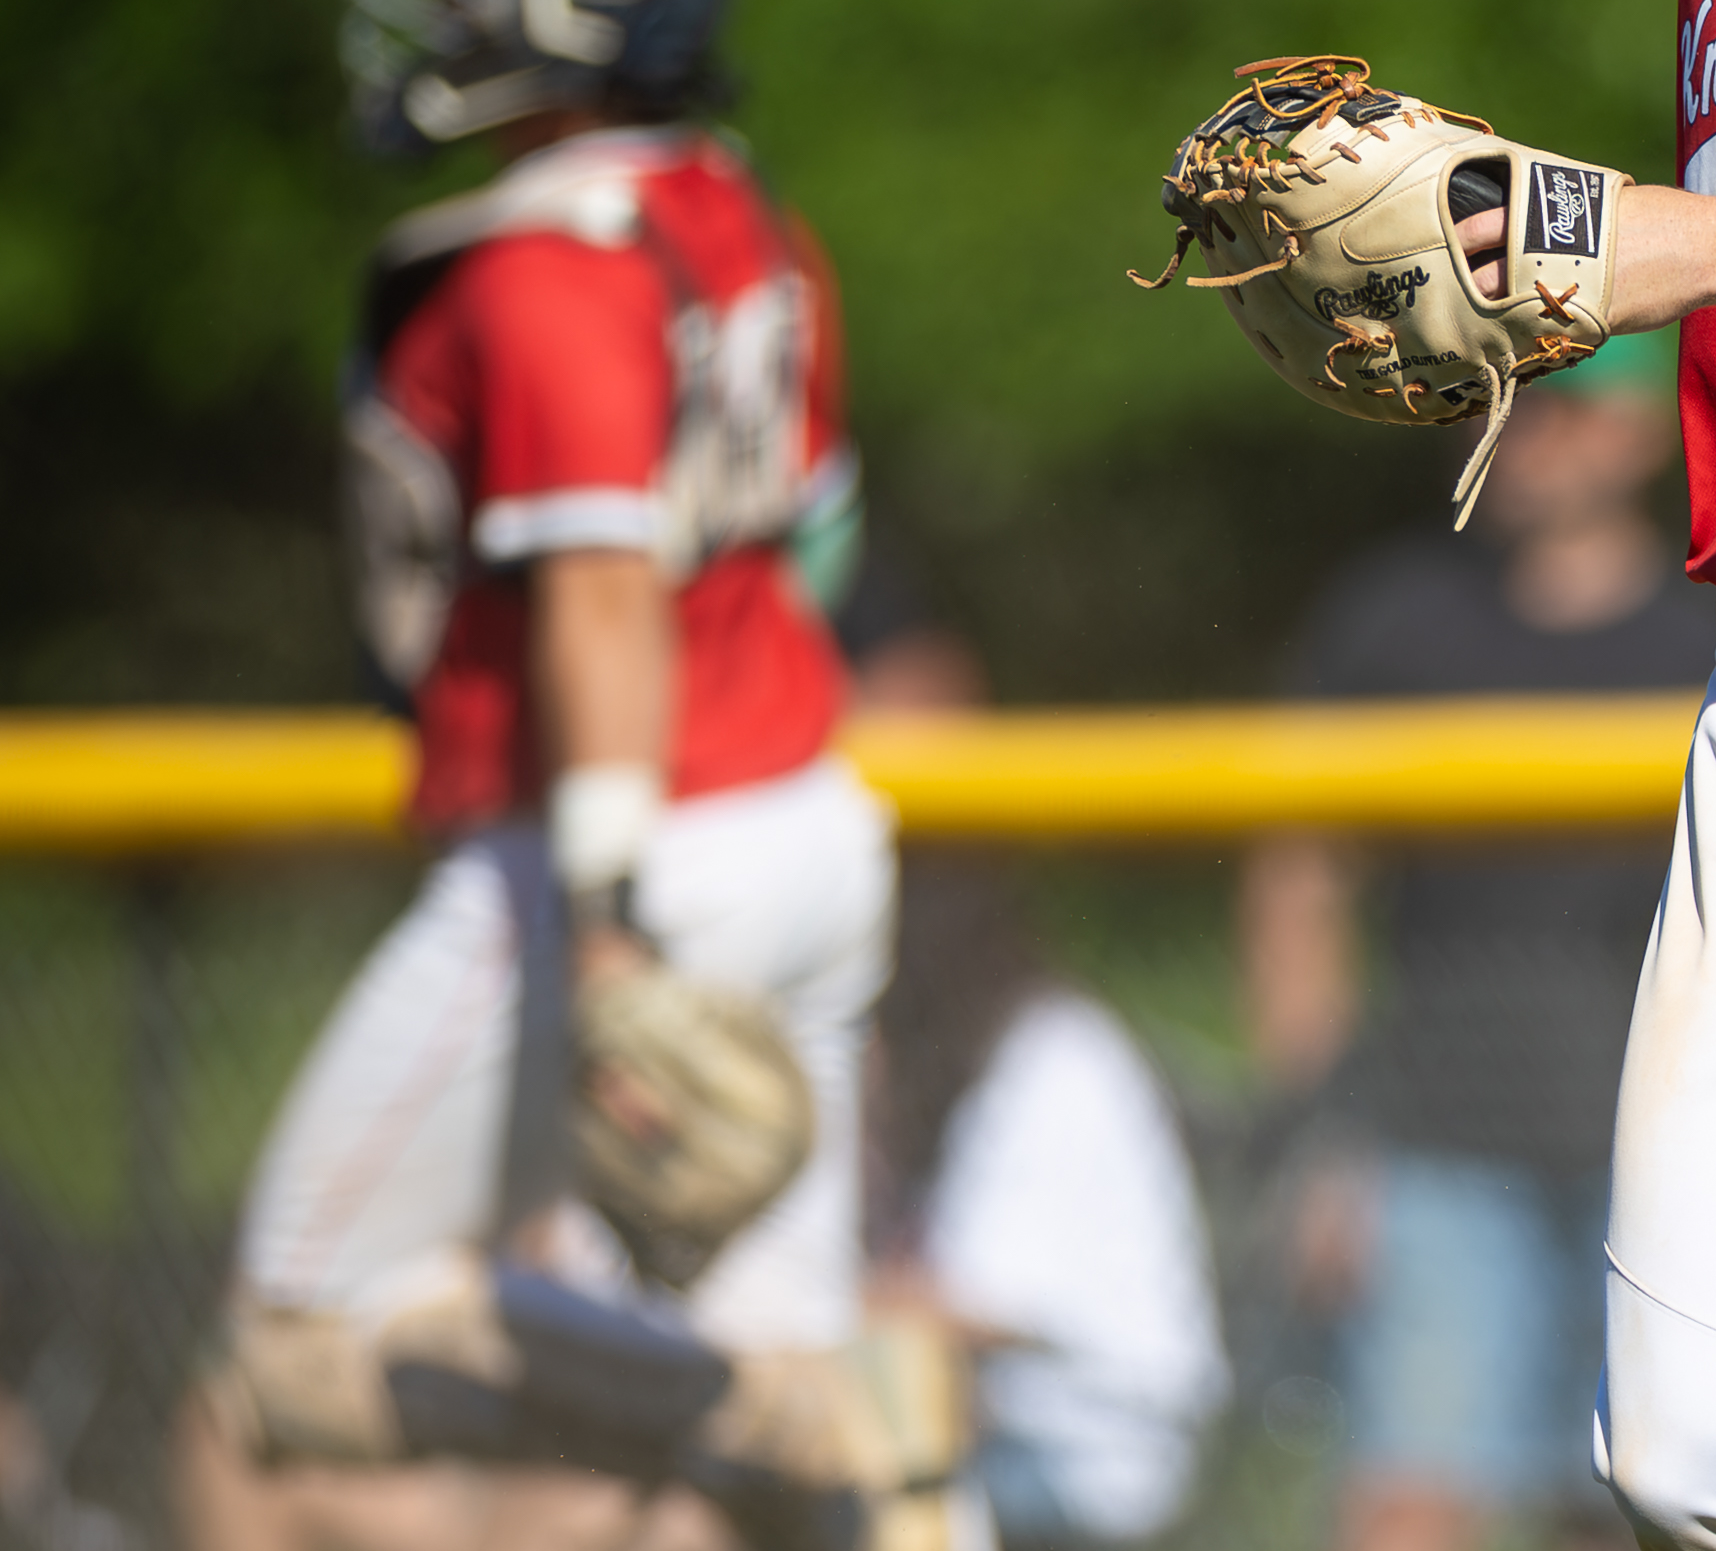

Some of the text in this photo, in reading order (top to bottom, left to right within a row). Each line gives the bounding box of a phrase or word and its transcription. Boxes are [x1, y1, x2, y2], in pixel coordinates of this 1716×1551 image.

[1547, 170, 1579, 245] Rawlings
[1314, 265, 1430, 321] Rawlings
[1355, 368, 1379, 380] THE
[1376, 356, 1413, 377] GOLD
[1410, 354, 1441, 368] GLOVE
